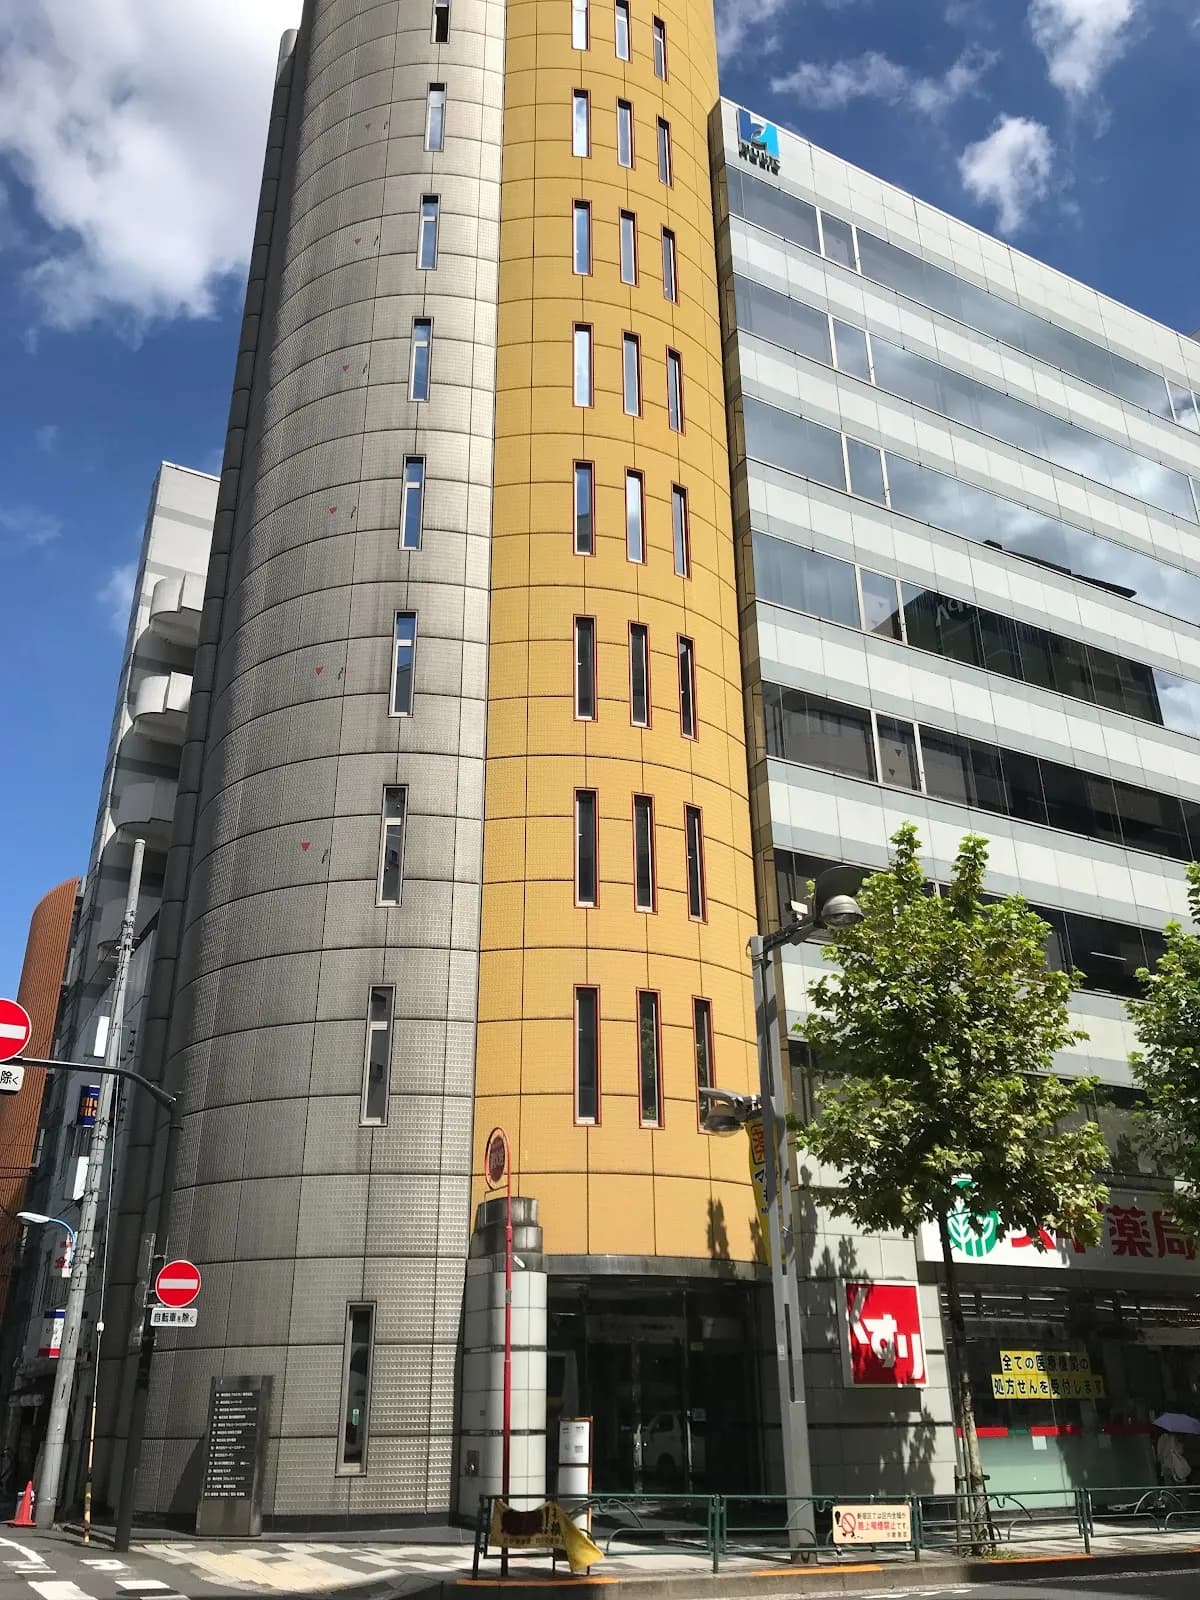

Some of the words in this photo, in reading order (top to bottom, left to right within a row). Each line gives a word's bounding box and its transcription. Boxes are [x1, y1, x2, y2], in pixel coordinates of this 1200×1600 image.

[0, 1070, 19, 1085] 除く
[153, 1312, 194, 1323] 自転車を除く
[850, 1287, 924, 1379] くすり
[1002, 1354, 1089, 1372] 全ての医療機関の
[994, 1378, 1102, 1396] 処方せんを受付します
